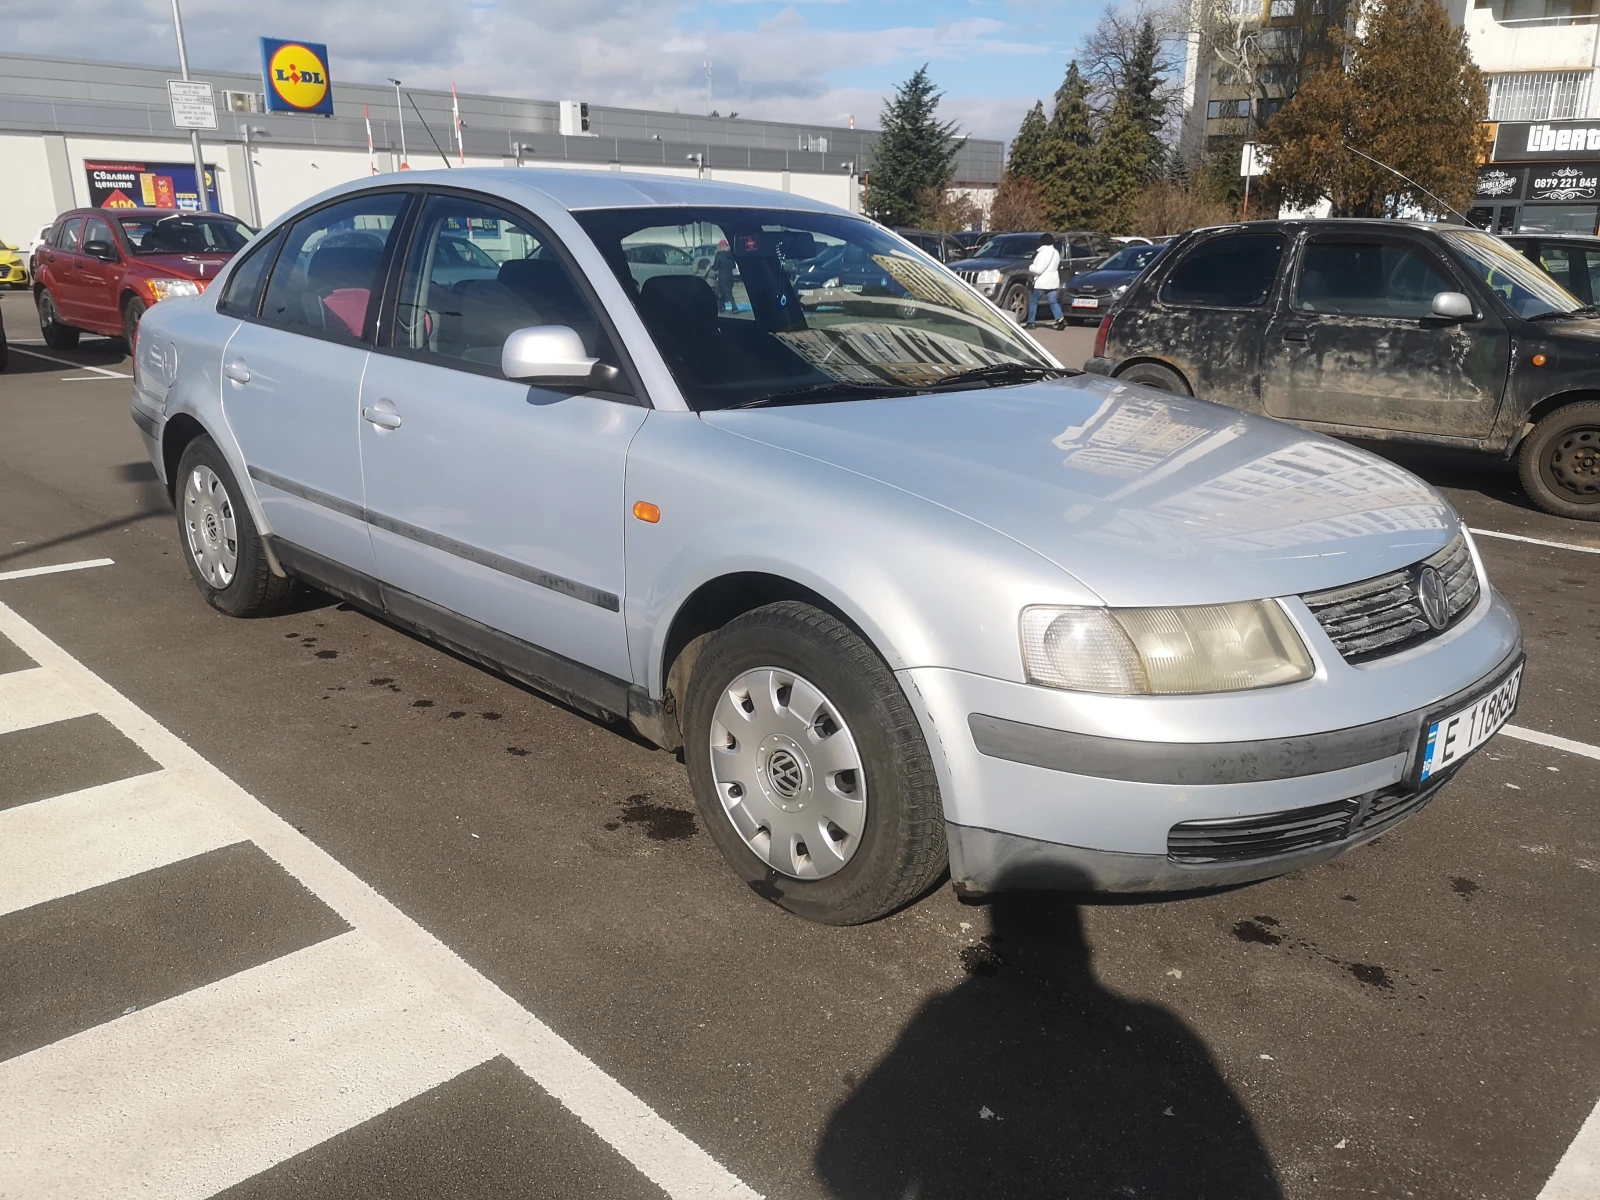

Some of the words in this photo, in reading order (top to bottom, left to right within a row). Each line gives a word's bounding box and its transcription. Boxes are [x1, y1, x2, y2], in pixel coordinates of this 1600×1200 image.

[93, 171, 136, 181] Сваляме
[95, 181, 133, 189] цените
[1534, 178, 1558, 188] 0879
[1560, 178, 1577, 188] 221
[1579, 177, 1598, 188] 845
[1442, 717, 1460, 764] E
